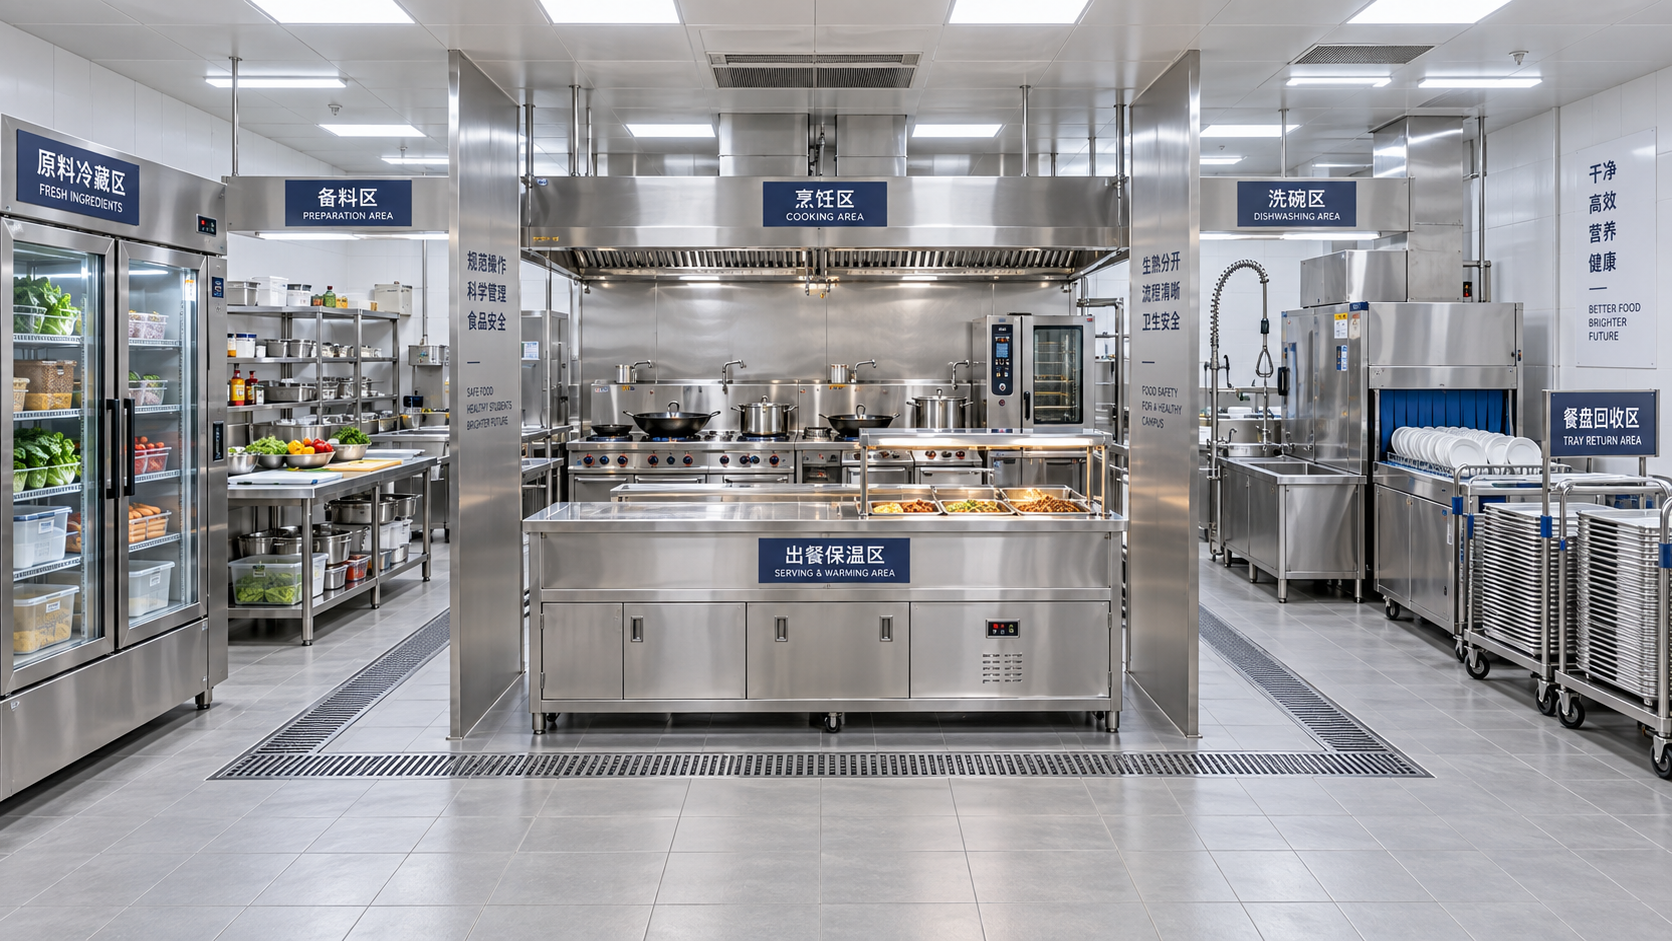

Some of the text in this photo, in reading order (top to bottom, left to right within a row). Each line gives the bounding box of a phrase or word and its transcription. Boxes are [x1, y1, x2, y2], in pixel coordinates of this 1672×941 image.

[37, 148, 126, 196] 原料冷藏区
[1588, 159, 1617, 184] 干净
[39, 183, 123, 213] FRESH INGREDIENTS
[317, 187, 378, 208] 备料区
[795, 188, 855, 209] 烹饪区
[1268, 188, 1326, 209] 洗碗区
[1588, 190, 1617, 215] 高效
[303, 211, 394, 220] PREPARATION AREA
[785, 212, 865, 221] COOKING AREA
[1254, 212, 1341, 221] DISHWASHING AREA
[1588, 220, 1617, 244] 营养
[467, 250, 507, 275] 规范操作
[1588, 250, 1617, 274] 健康
[466, 280, 507, 303] 科学管理
[1588, 302, 1641, 314] BETTER FOOD
[467, 310, 507, 332] 食品安全
[1142, 310, 1181, 331] 卫生安全
[1588, 316, 1627, 328] BRIGHTER
[1588, 330, 1619, 342] FUTURE
[1563, 406, 1640, 430] 餐盘回收区
[1563, 435, 1642, 446] TRAY RETURN AREA
[785, 544, 885, 565] 出餐保温区
[774, 568, 896, 578] SERVING & WARMING AREA
